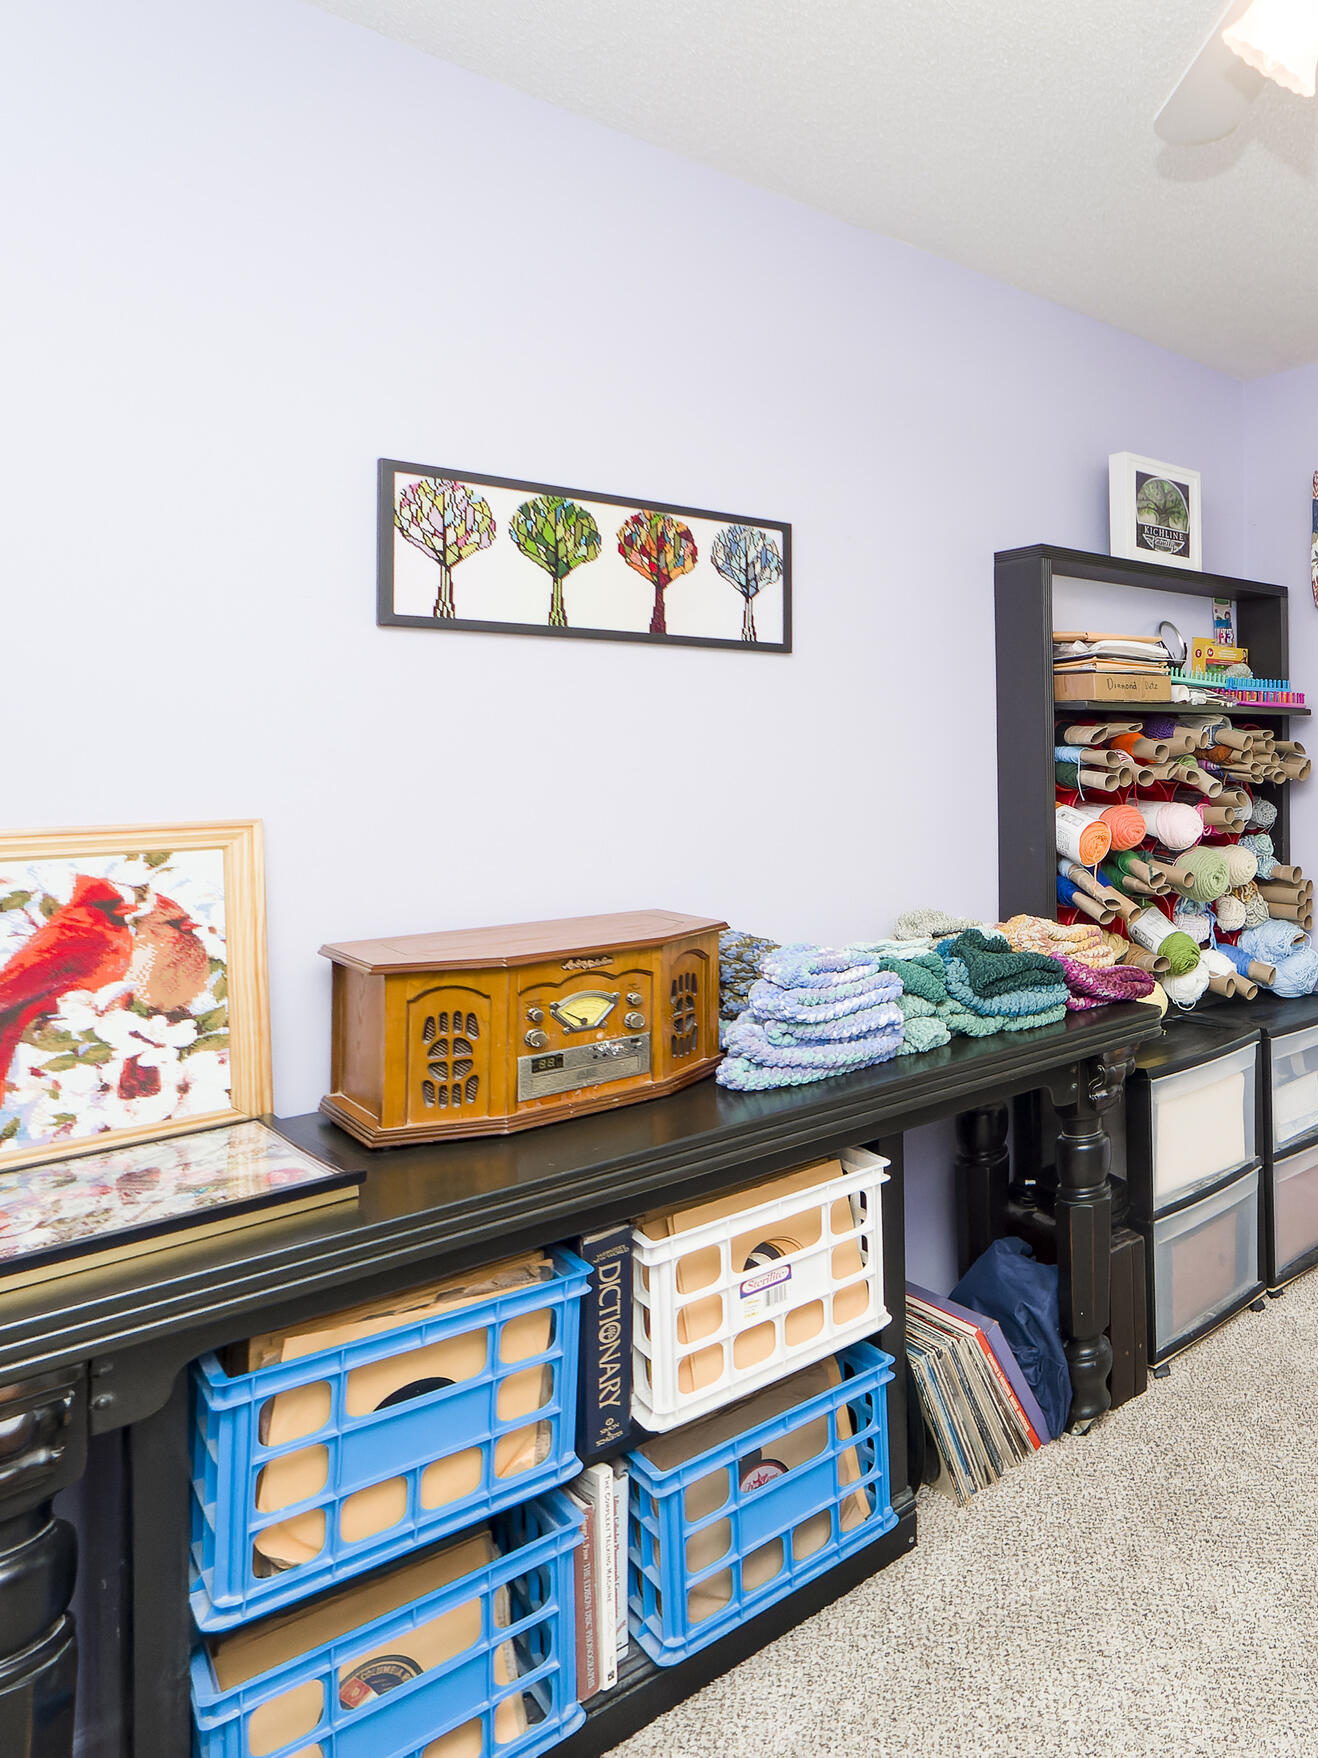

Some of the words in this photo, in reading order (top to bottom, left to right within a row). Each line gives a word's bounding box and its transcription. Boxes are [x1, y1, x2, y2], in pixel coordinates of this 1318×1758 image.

[1144, 525, 1184, 541] KICHLINE
[1107, 677, 1137, 690] Diamond
[599, 1260, 621, 1409] DICTIONARY
